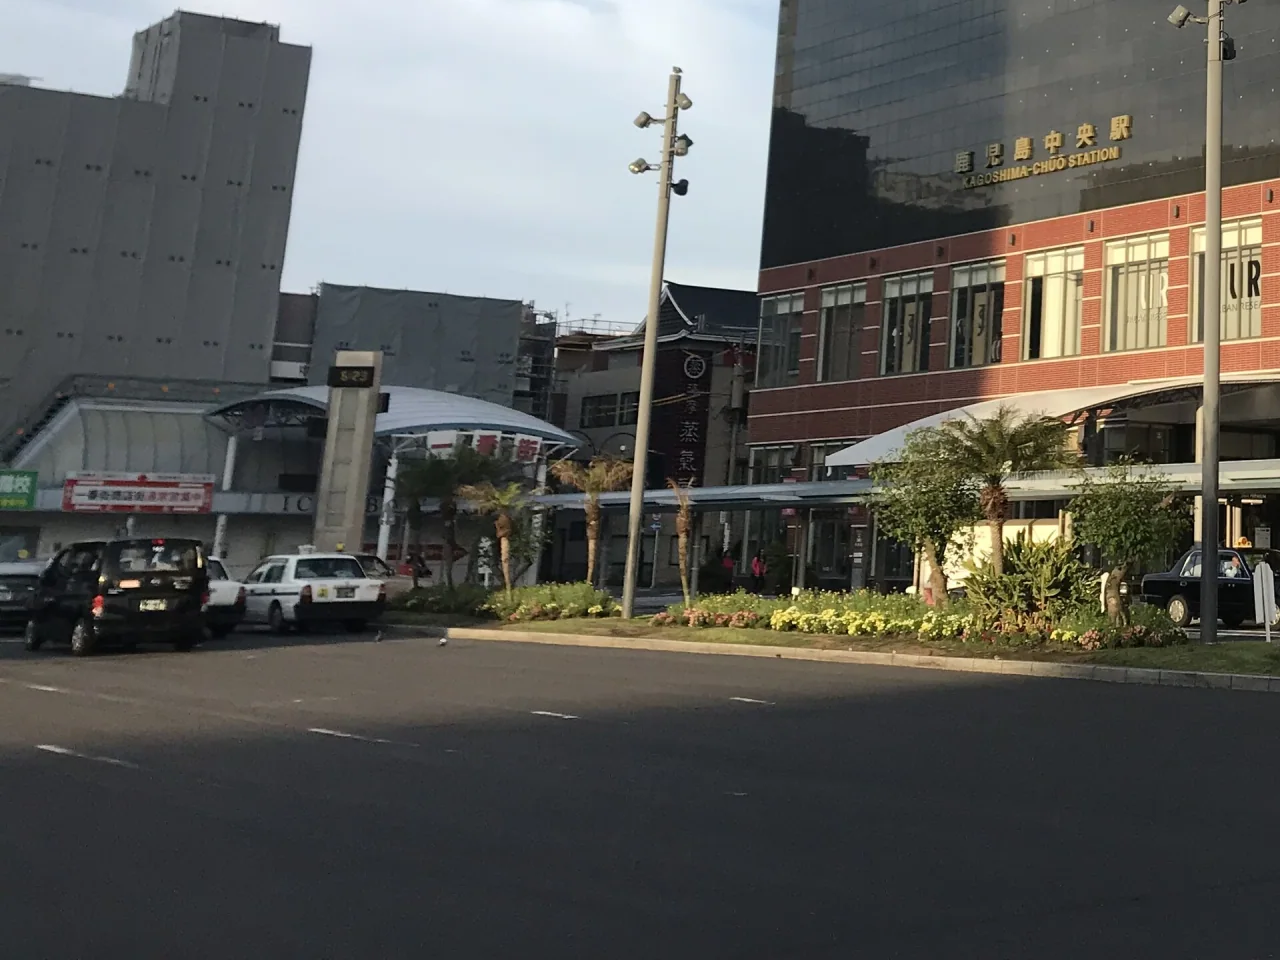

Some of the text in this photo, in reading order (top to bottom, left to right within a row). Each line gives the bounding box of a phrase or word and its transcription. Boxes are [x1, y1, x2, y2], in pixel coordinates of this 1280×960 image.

[955, 114, 1132, 173] 鹿児島中央駅
[1068, 146, 1121, 168] STATION
